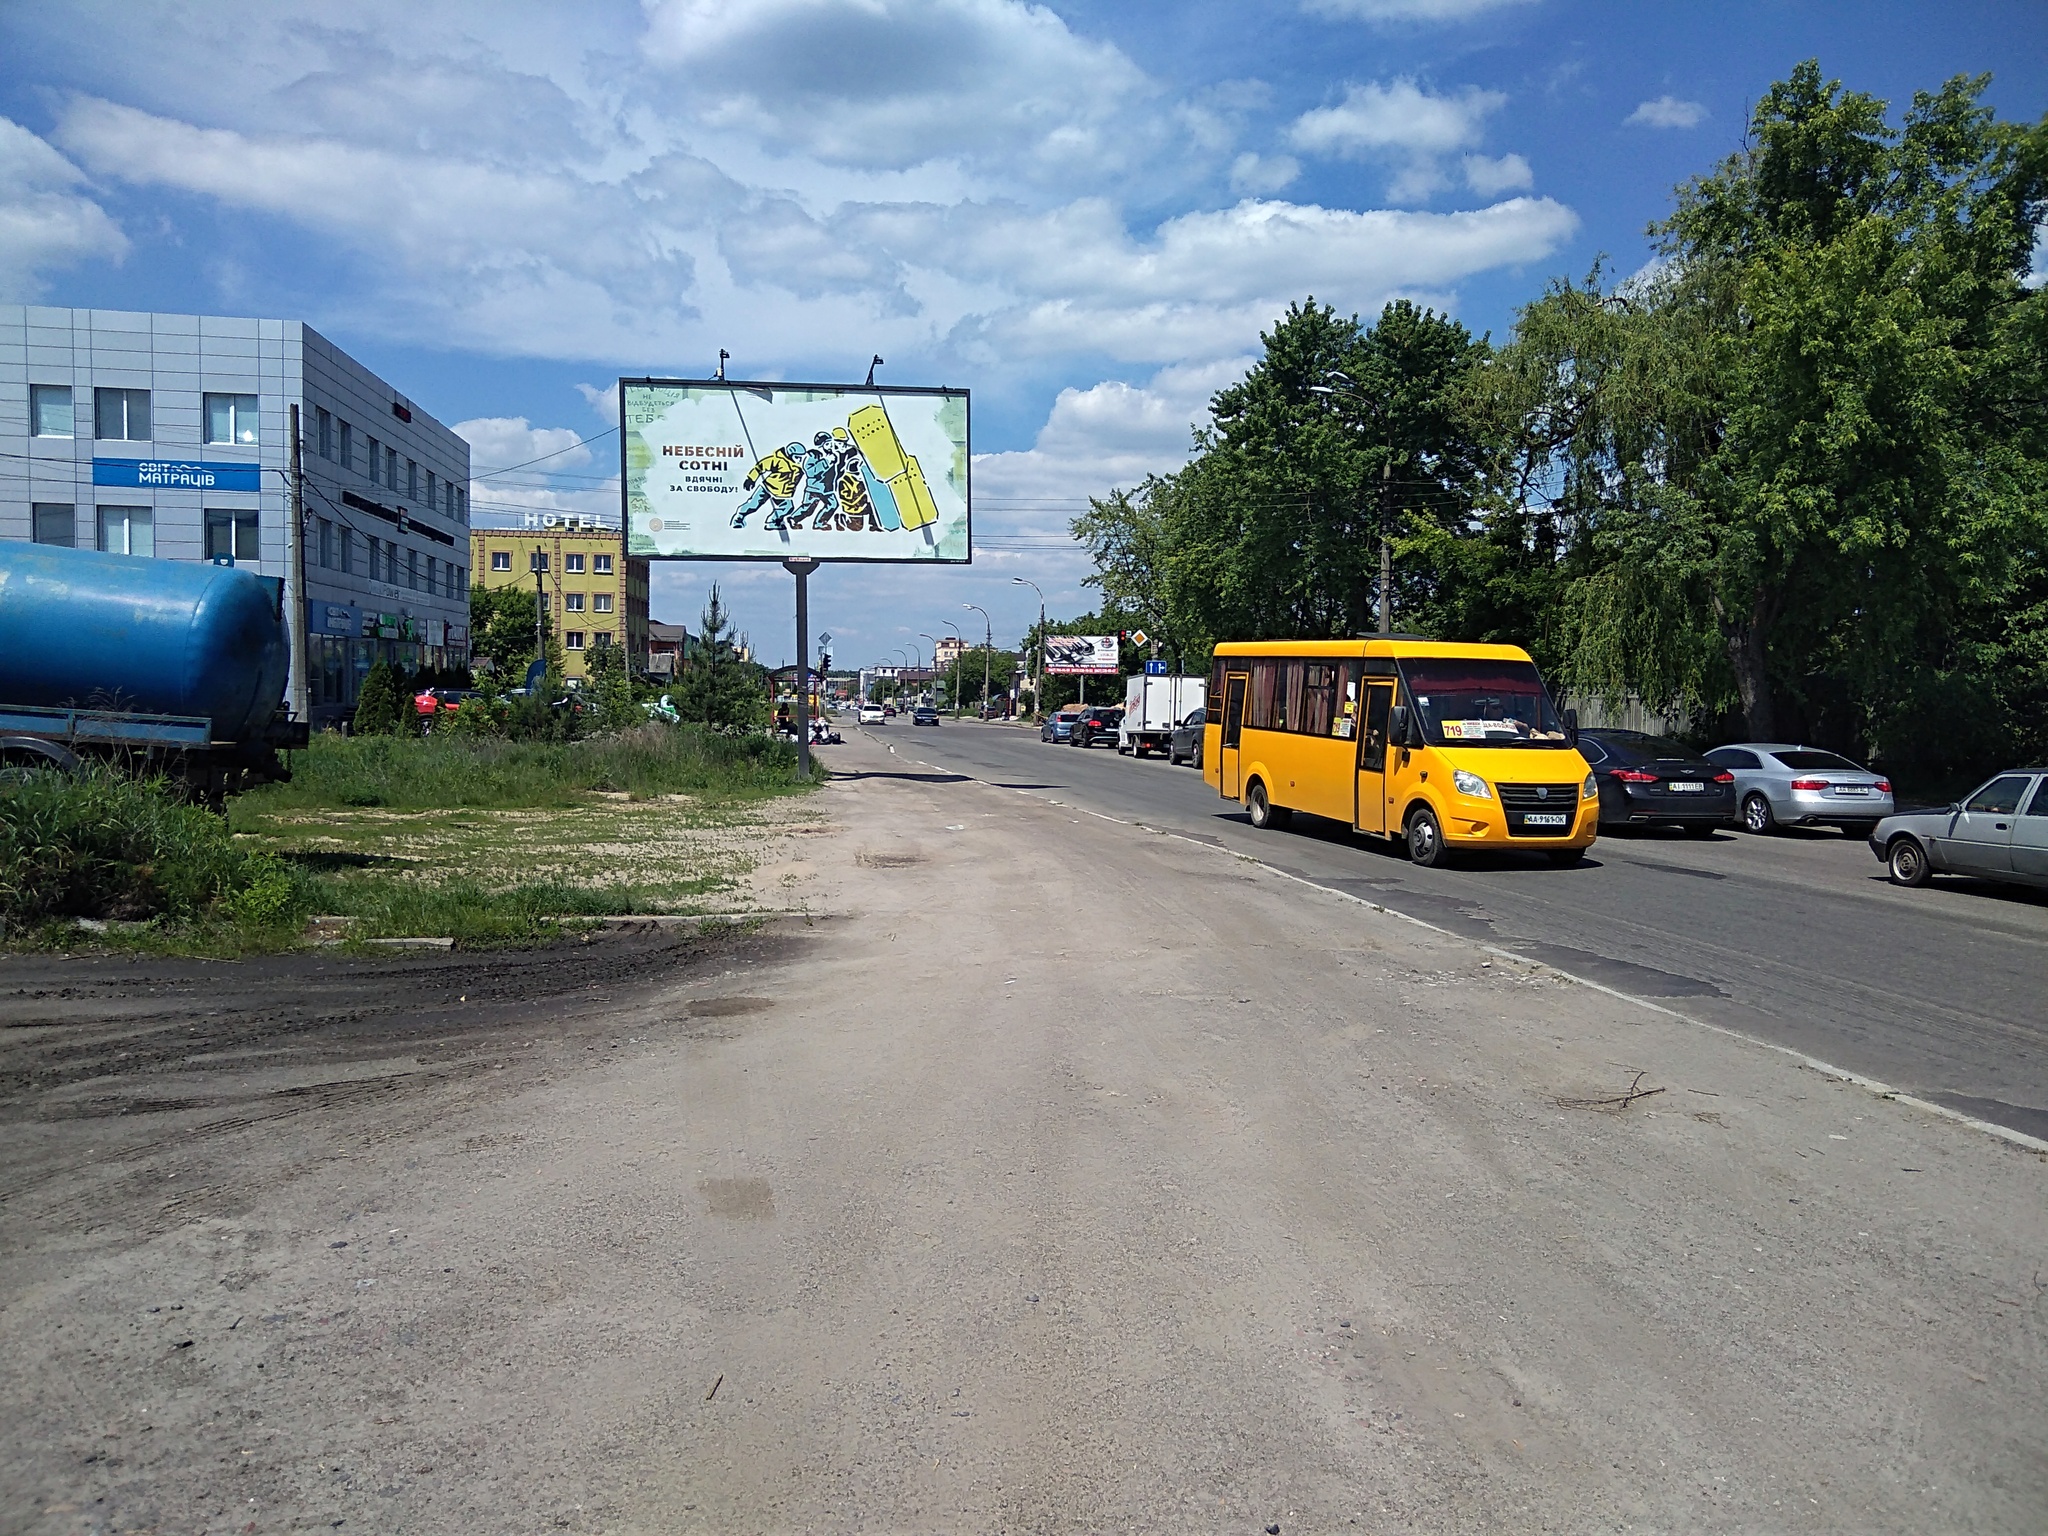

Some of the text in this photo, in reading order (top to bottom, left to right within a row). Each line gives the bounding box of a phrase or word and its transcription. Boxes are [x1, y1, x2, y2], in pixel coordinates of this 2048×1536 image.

[662, 444, 744, 458] НЕБЕСНІЙ
[139, 462, 171, 473] СВІТ
[679, 460, 728, 471] СОТНІ
[138, 472, 215, 487] МАТРАЦІВ
[685, 475, 723, 484] ВДЯЧНІ
[686, 485, 738, 494] СВОБОДУ!
[524, 512, 607, 529] HOTEL
[1444, 725, 1463, 737] 719
